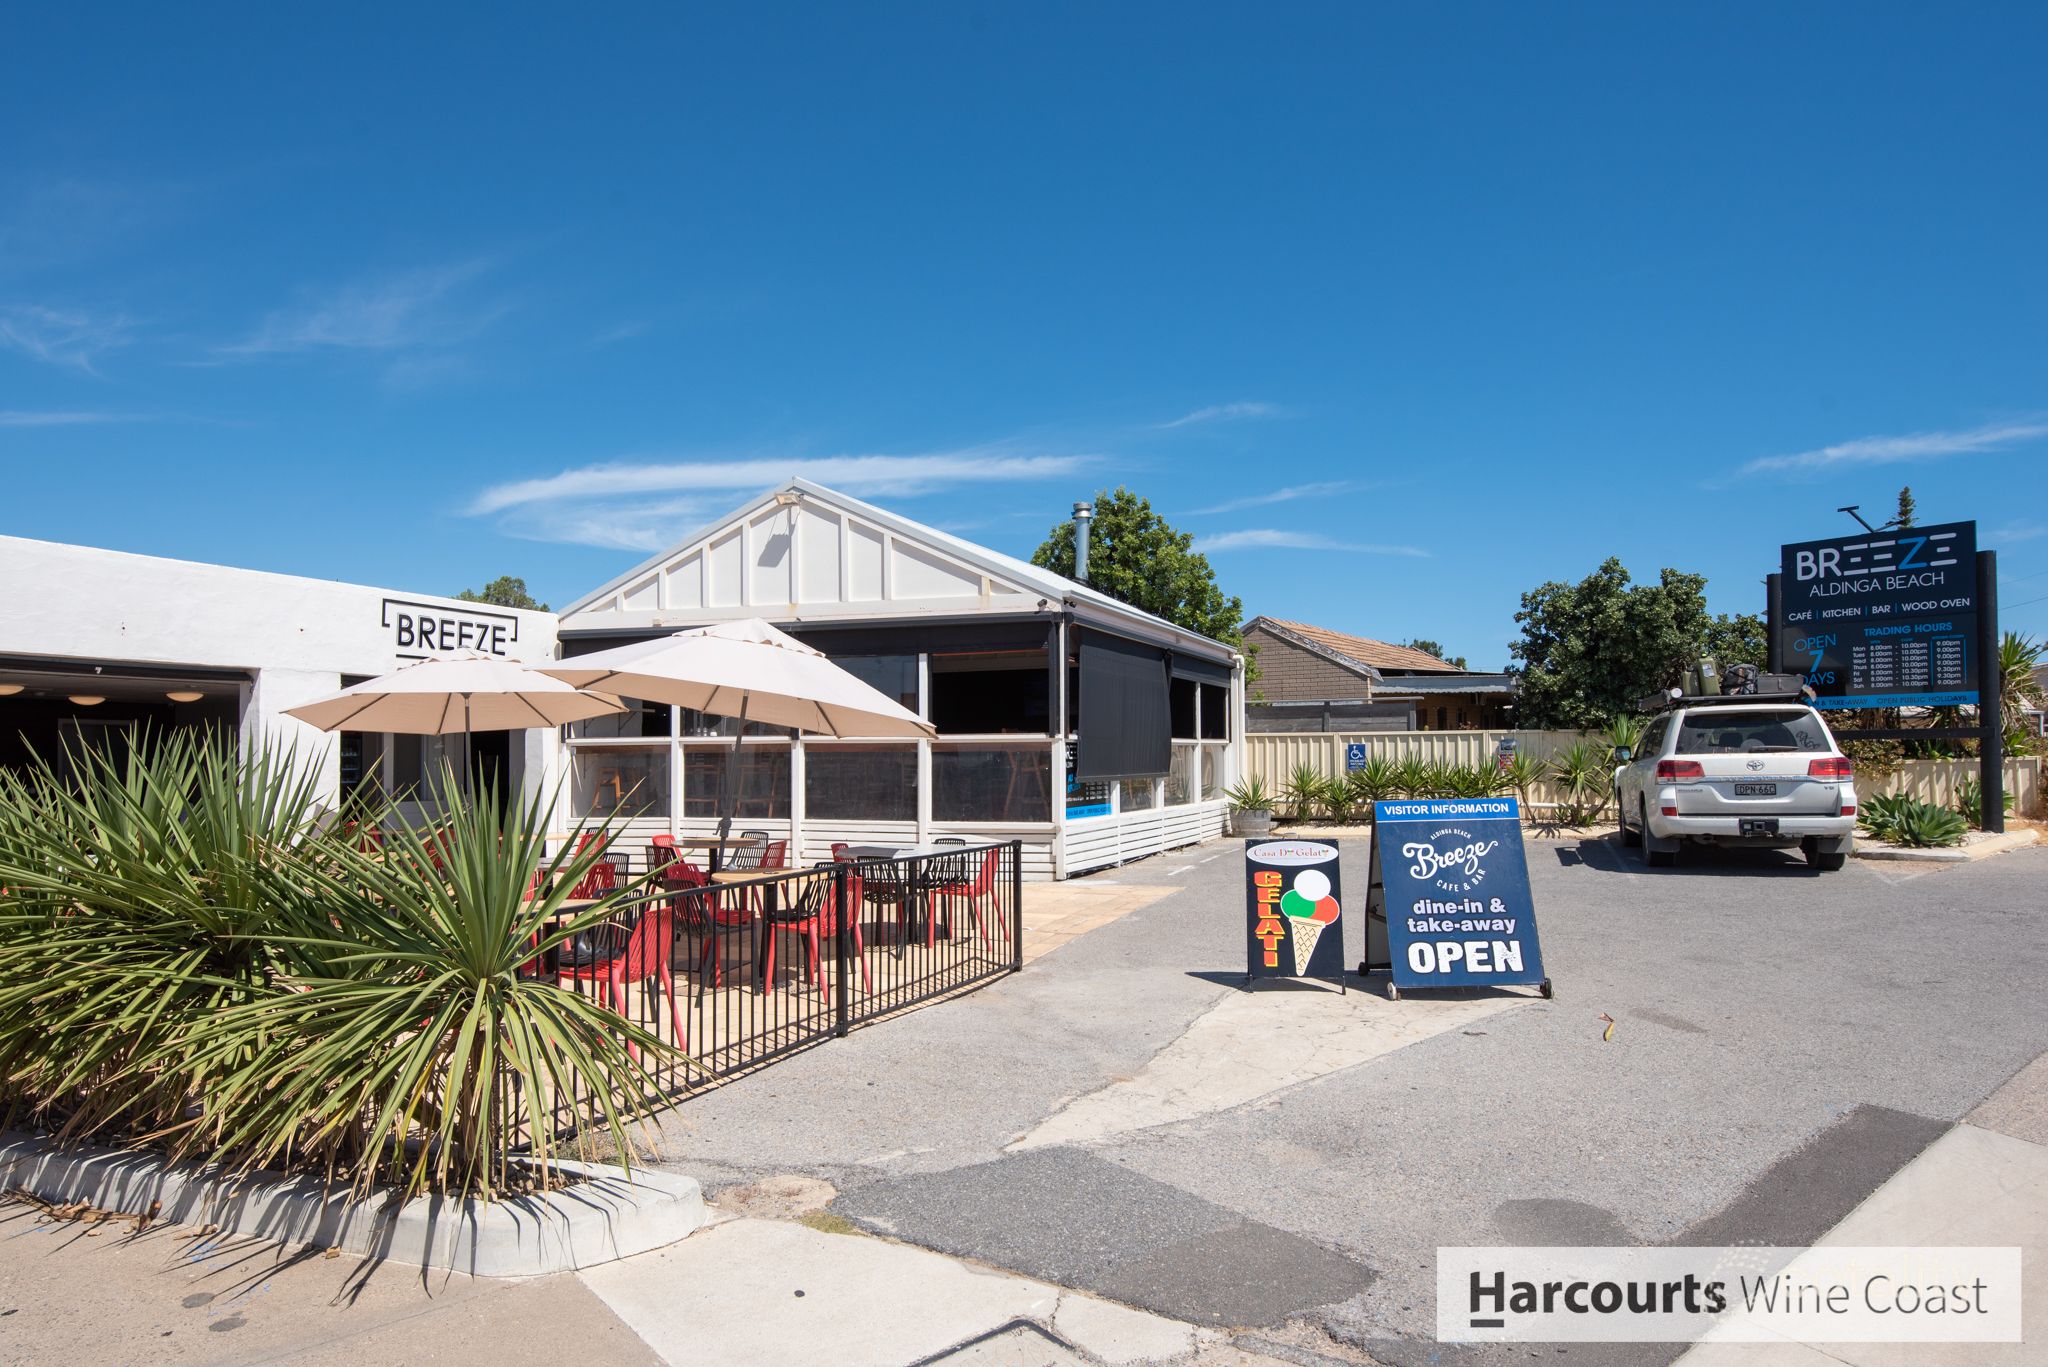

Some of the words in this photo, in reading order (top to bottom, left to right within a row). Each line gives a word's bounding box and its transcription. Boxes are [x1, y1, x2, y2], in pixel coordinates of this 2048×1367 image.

[1796, 533, 1957, 580] BREEZE
[1810, 578, 1880, 597] ALDINGA
[1886, 572, 1944, 590] BEACH
[1789, 610, 1812, 621] CAFÉ
[1822, 608, 1860, 618] KITCHEN
[1872, 605, 1890, 614] BAR
[1902, 600, 1937, 612] WOOD
[1940, 598, 1970, 608] OVEN
[397, 613, 506, 656] BREEZE
[1864, 625, 1911, 636] TRADING
[1915, 622, 1952, 632] HOURS
[1794, 634, 1836, 651] OPEN
[1809, 649, 1824, 672] 7
[1828, 698, 1868, 706] TAKE-AWAY
[1384, 805, 1429, 815] VISITOR
[1432, 803, 1508, 814] INFORMATION
[1430, 829, 1451, 840] ALDINGA
[1454, 828, 1472, 839] BEACH
[1402, 840, 1498, 880] Breeze
[1436, 879, 1459, 892] CAFE
[1464, 882, 1471, 890] &
[1473, 868, 1486, 885] BAR
[1413, 898, 1483, 914] dine-in
[1490, 898, 1506, 912] &
[1254, 871, 1285, 967] GELATI
[1407, 918, 1516, 934] take-away
[1408, 940, 1524, 973] OPEN
